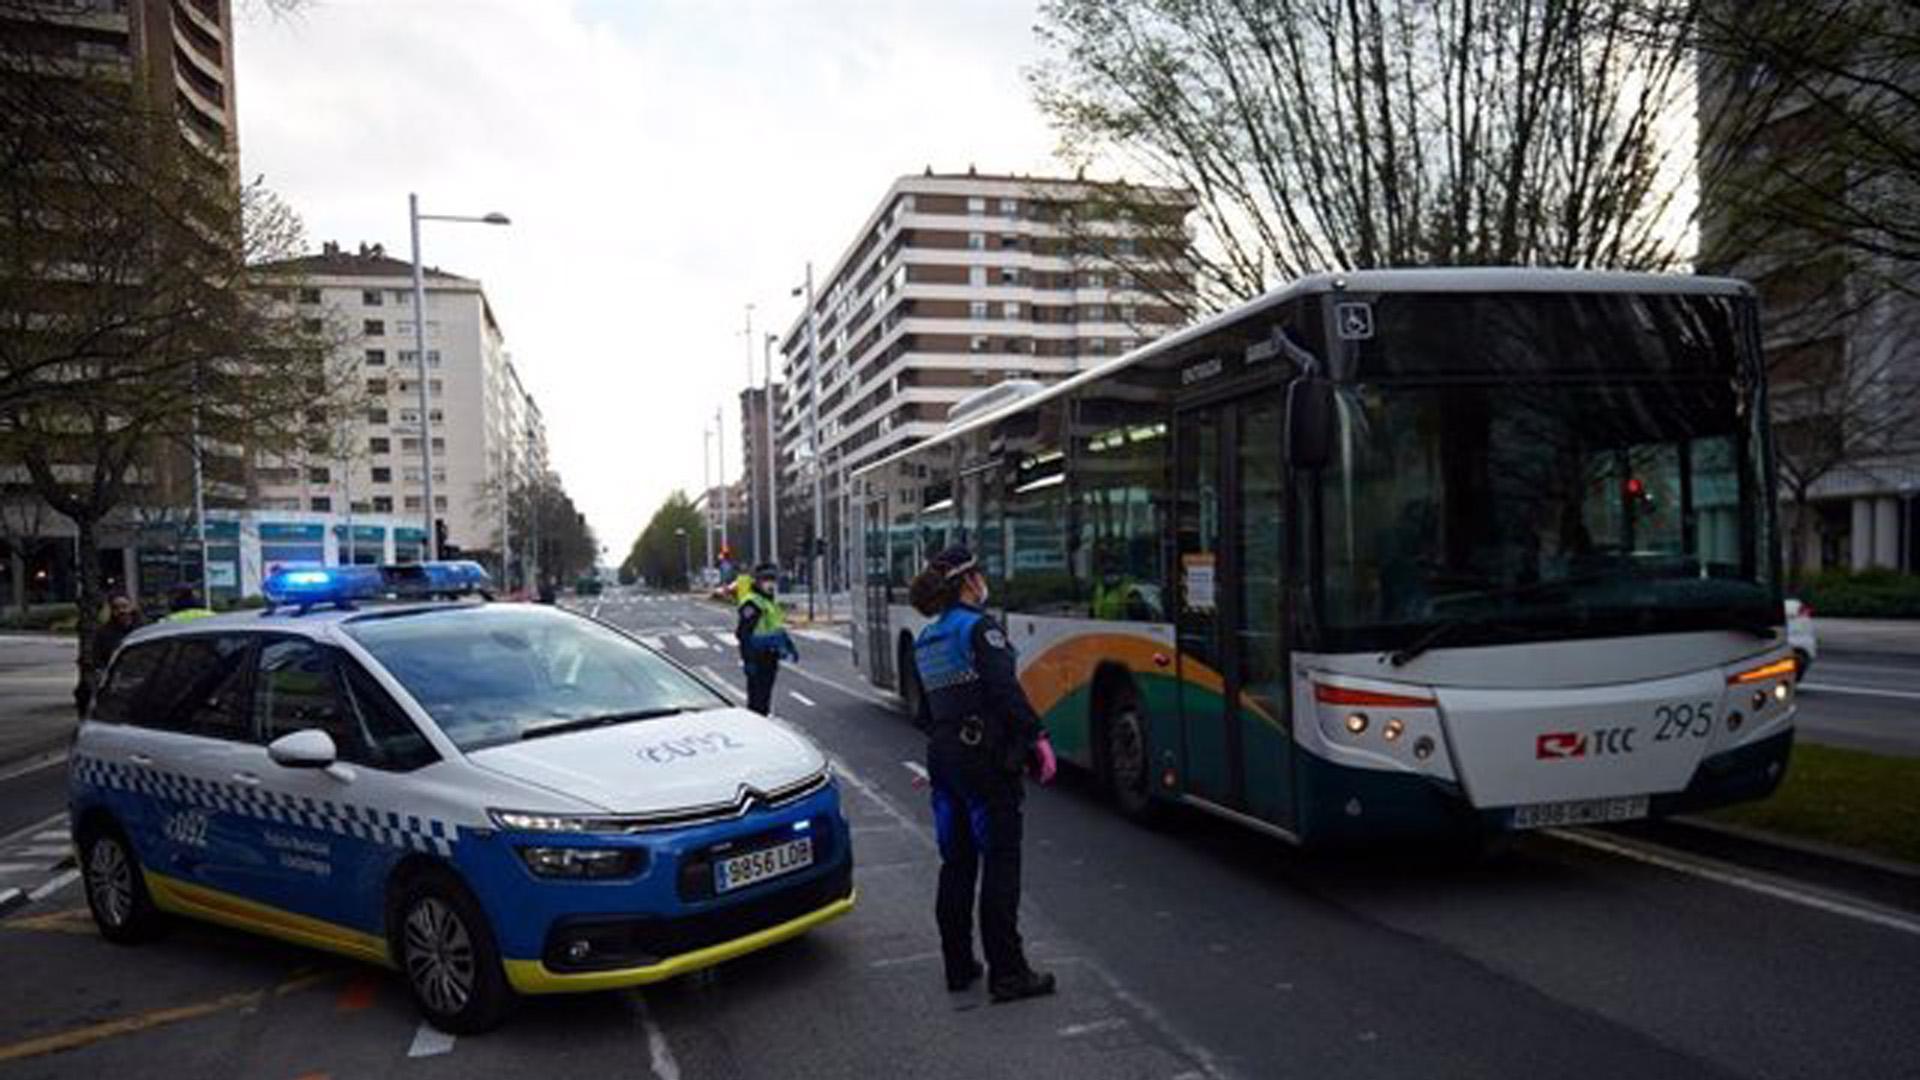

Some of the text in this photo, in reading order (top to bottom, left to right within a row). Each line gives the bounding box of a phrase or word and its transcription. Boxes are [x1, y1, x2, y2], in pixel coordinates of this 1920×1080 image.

[1655, 702, 1713, 741] 295
[1594, 727, 1635, 754] TCC
[729, 850, 776, 883] 9856
